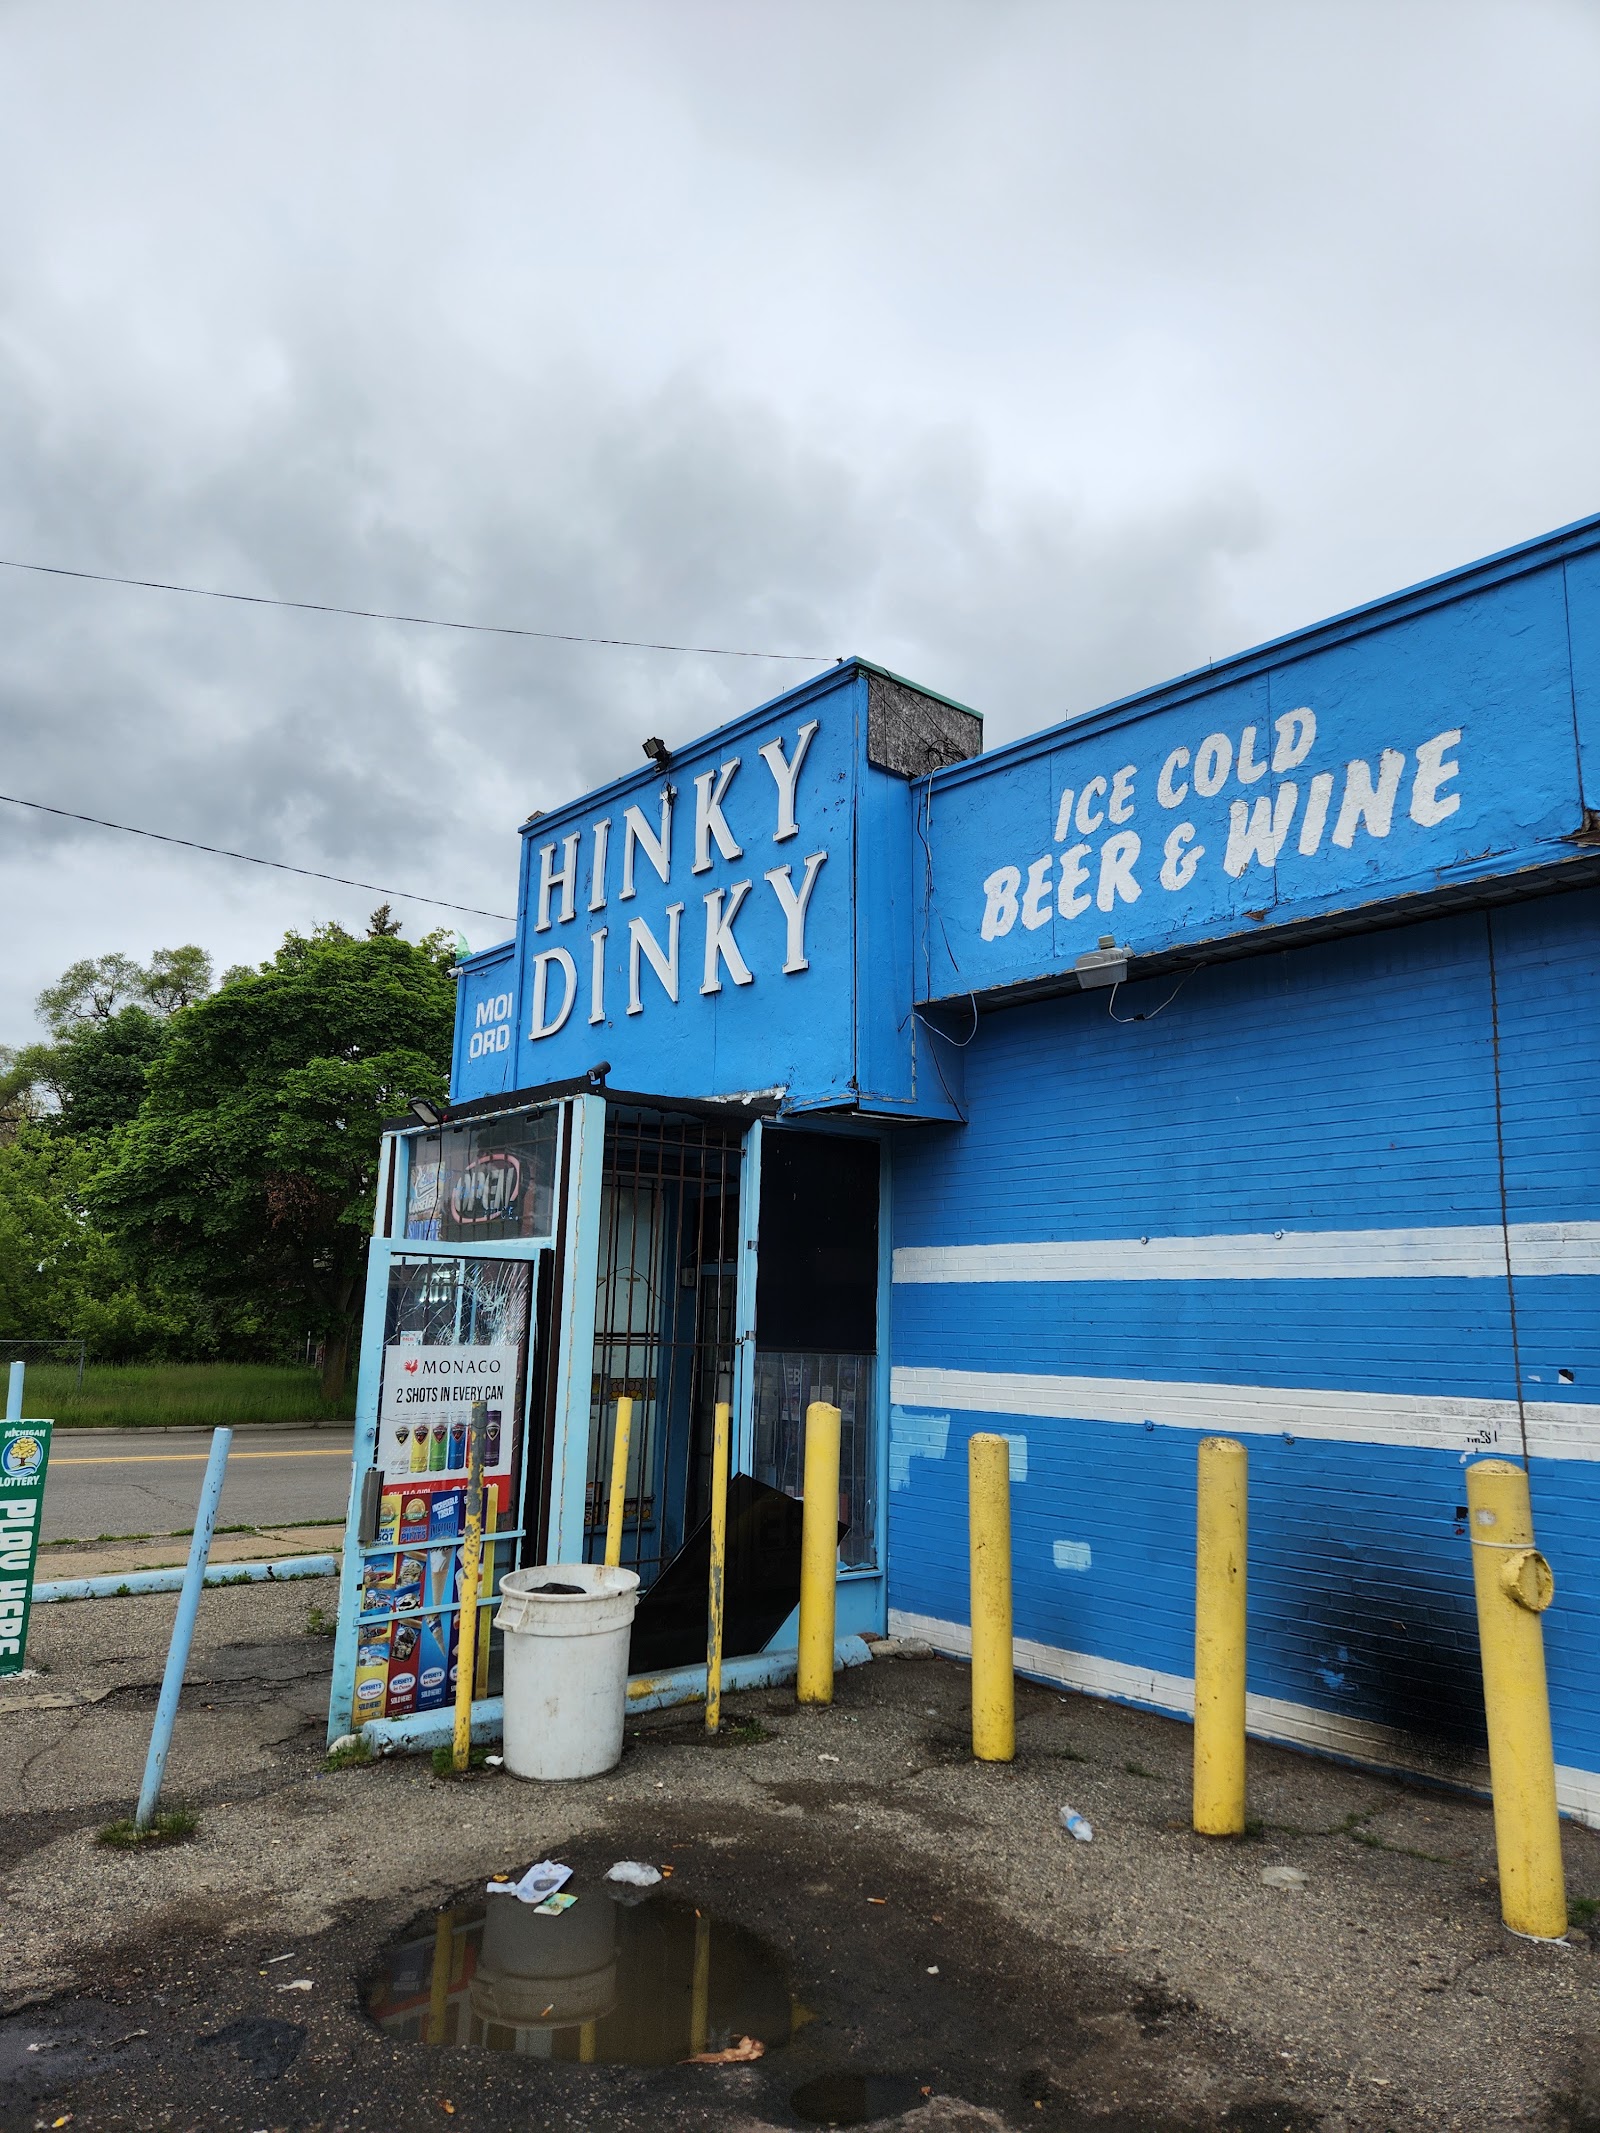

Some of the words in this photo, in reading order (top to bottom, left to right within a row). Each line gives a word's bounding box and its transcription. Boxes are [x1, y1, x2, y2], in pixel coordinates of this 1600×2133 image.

[1053, 765, 1138, 843] ICE
[1157, 706, 1317, 809] COLD
[534, 719, 820, 933] HINKY
[980, 830, 1142, 942] BEER
[1159, 822, 1205, 891] &
[1223, 728, 1463, 879] WINE
[529, 850, 828, 1041] DINKY
[469, 1024, 510, 1059] ORD
[422, 1360, 501, 1374] MONACO
[396, 1388, 403, 1403] 2
[406, 1387, 438, 1403] SHOTS
[440, 1386, 450, 1402] IN
[453, 1385, 482, 1401] EVERY
[485, 1385, 504, 1400] CAN
[4, 1427, 46, 1438] MICHIGAN
[0, 1475, 41, 1487] LOTTERY
[432, 1495, 459, 1513] INCREDIBLE
[0, 1498, 37, 1571] PLAY
[401, 1531, 426, 1543] PINTS
[0, 1579, 27, 1656] HERE
